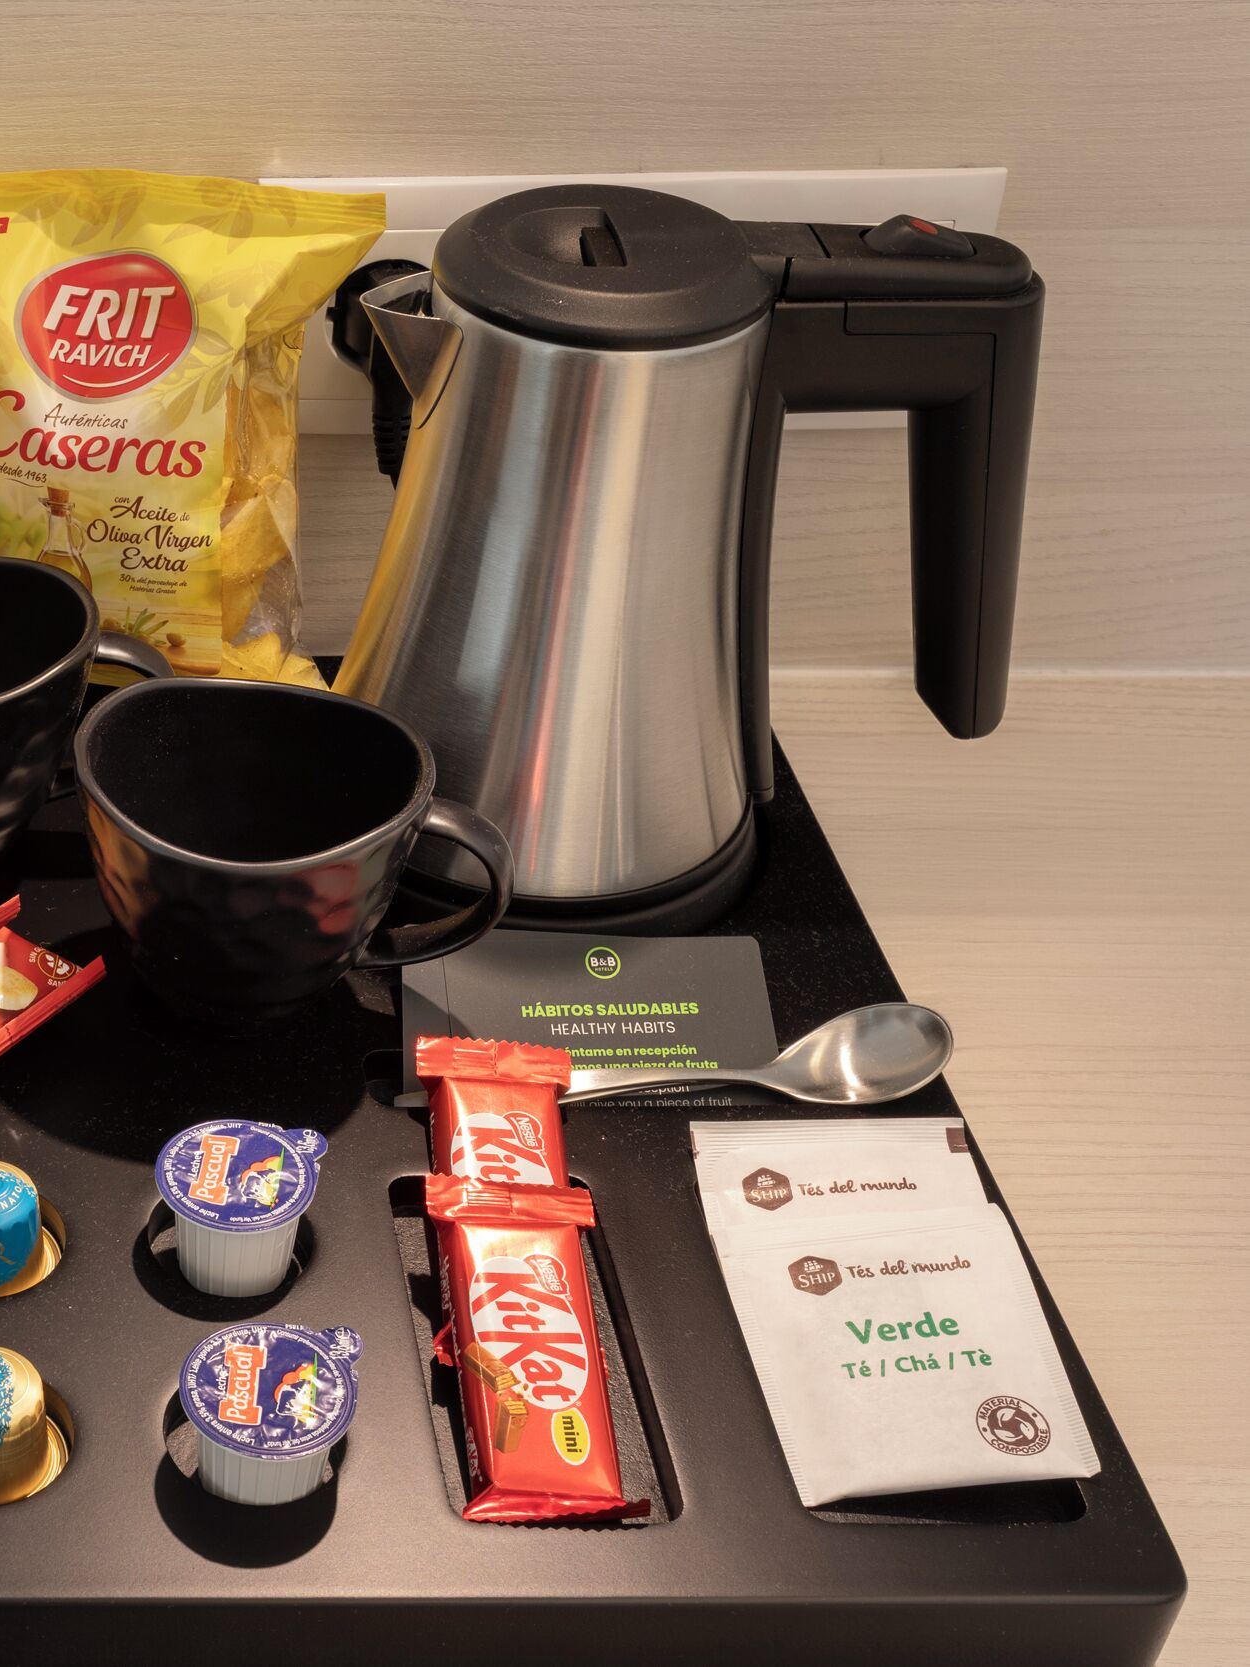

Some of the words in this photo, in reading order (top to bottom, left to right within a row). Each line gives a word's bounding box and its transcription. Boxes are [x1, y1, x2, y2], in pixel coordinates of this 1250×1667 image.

[42, 284, 175, 341] FRIT
[49, 337, 152, 368] RAVICH
[44, 403, 128, 429] Auténticas
[25, 471, 47, 484] 1963
[110, 495, 178, 523] Aceite
[114, 496, 131, 504] con
[86, 518, 143, 545] Oliva
[144, 524, 213, 552] Virgen
[120, 546, 189, 572] Extra
[589, 956, 616, 967] B&B
[521, 1001, 595, 1018] HÁBITOS
[596, 1002, 700, 1017] SALUDABLES
[550, 1022, 617, 1037] HEALTHY
[621, 1021, 677, 1035] HABITS
[615, 1047, 632, 1057] en
[633, 1044, 697, 1058] recepción
[685, 1060, 719, 1070] fruta
[693, 1096, 706, 1107] of
[706, 1096, 733, 1107] fruit
[188, 1150, 204, 1178] Leche
[195, 1140, 227, 1199] Pascual
[749, 1187, 789, 1203] SHIP
[797, 1182, 825, 1197] Tés
[828, 1180, 857, 1195] del
[860, 1177, 918, 1192] mundo
[798, 1271, 836, 1288] SHIP
[844, 1262, 875, 1279] Tés
[880, 1259, 909, 1276] del
[911, 1254, 972, 1274] mundo
[844, 1311, 960, 1345] Verde
[841, 1359, 872, 1379] Té
[894, 1353, 941, 1374] Chá
[960, 1348, 993, 1368] Tè
[225, 1350, 254, 1420] Pascual
[978, 1397, 1024, 1421] MATERIAL
[561, 1415, 582, 1454] mini
[990, 1428, 1049, 1455] COMPOSTABLE
